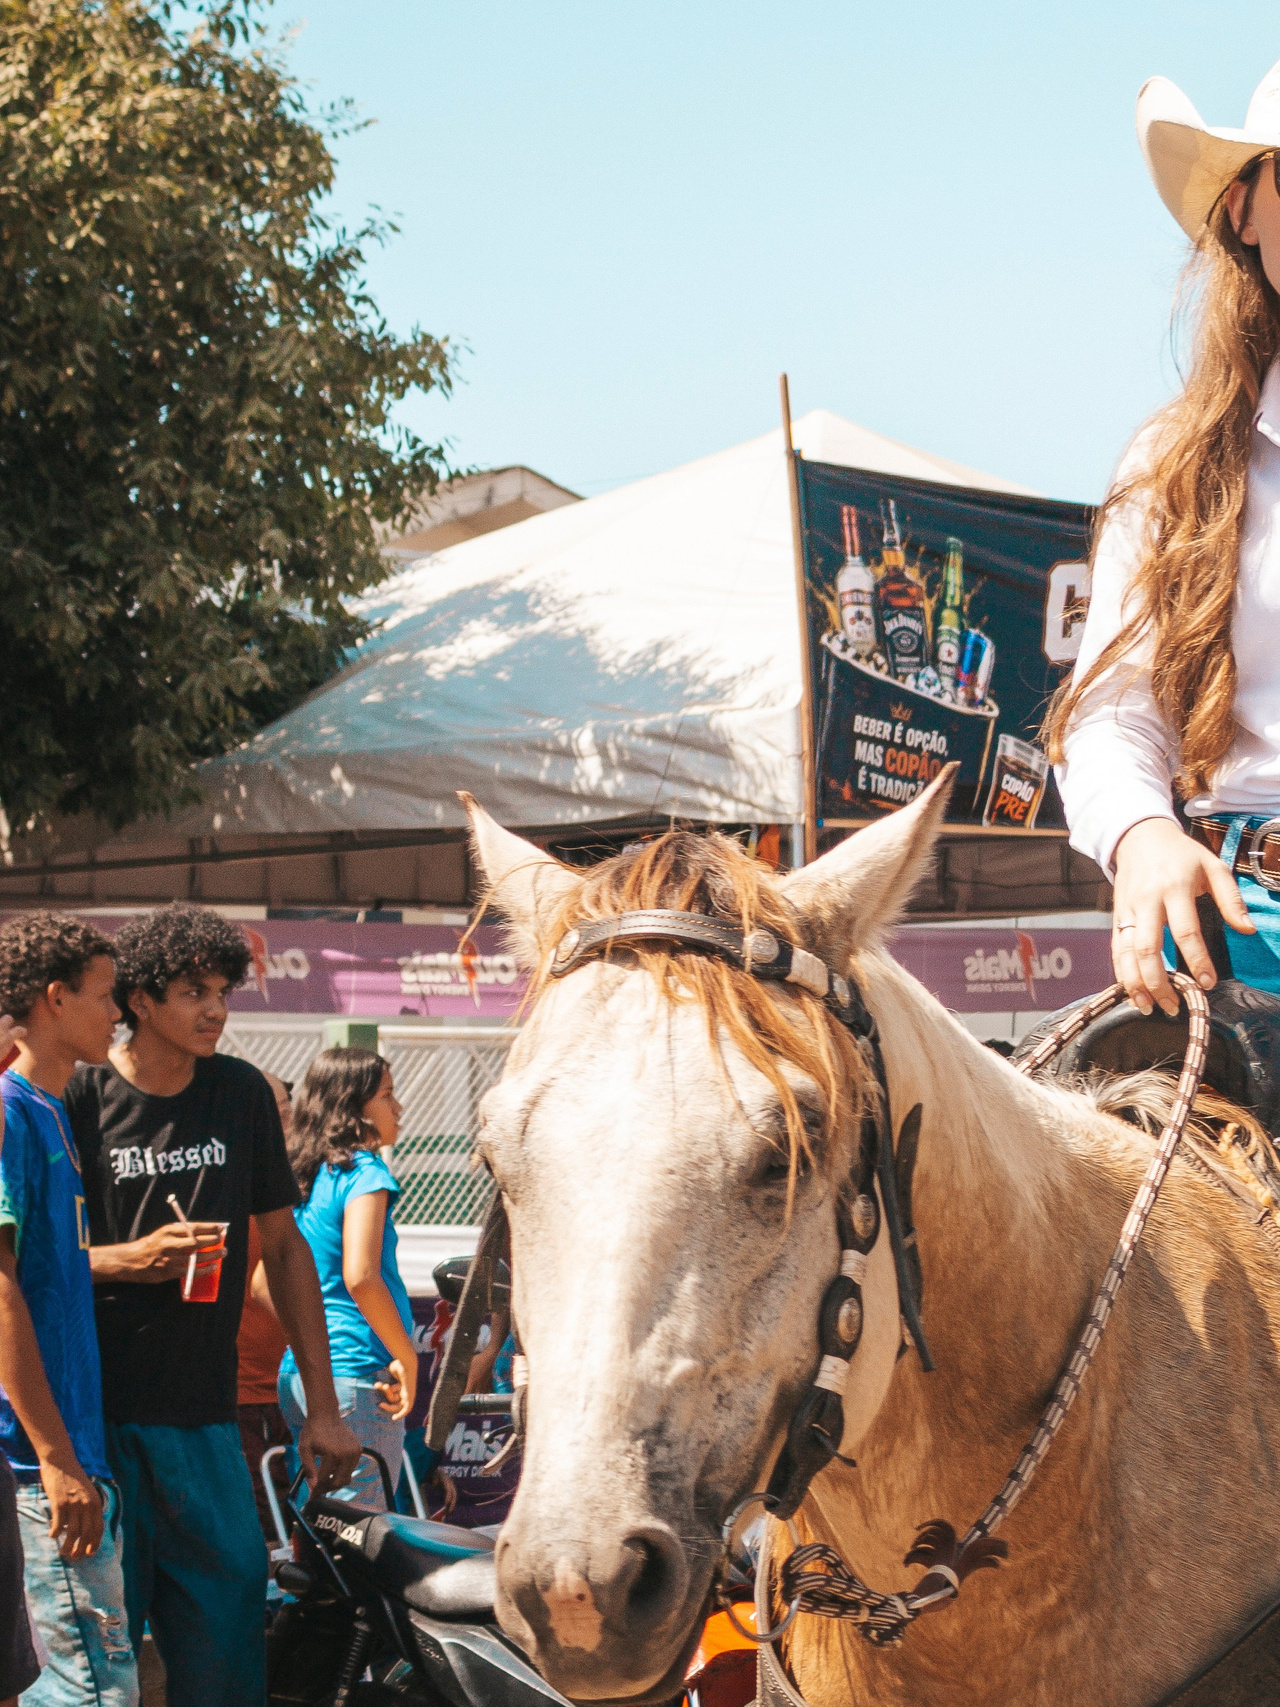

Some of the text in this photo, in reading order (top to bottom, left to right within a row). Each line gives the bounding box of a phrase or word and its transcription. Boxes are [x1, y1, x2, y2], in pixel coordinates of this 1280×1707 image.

[853, 714, 949, 757] BEBER É OPÇÃO,
[854, 740, 884, 768] MAS
[857, 766, 925, 804] É TRADIÇÃ
[1001, 773, 1035, 802] COPÃO
[109, 1137, 226, 1185] Blessed
[315, 1514, 365, 1546] HONDA
